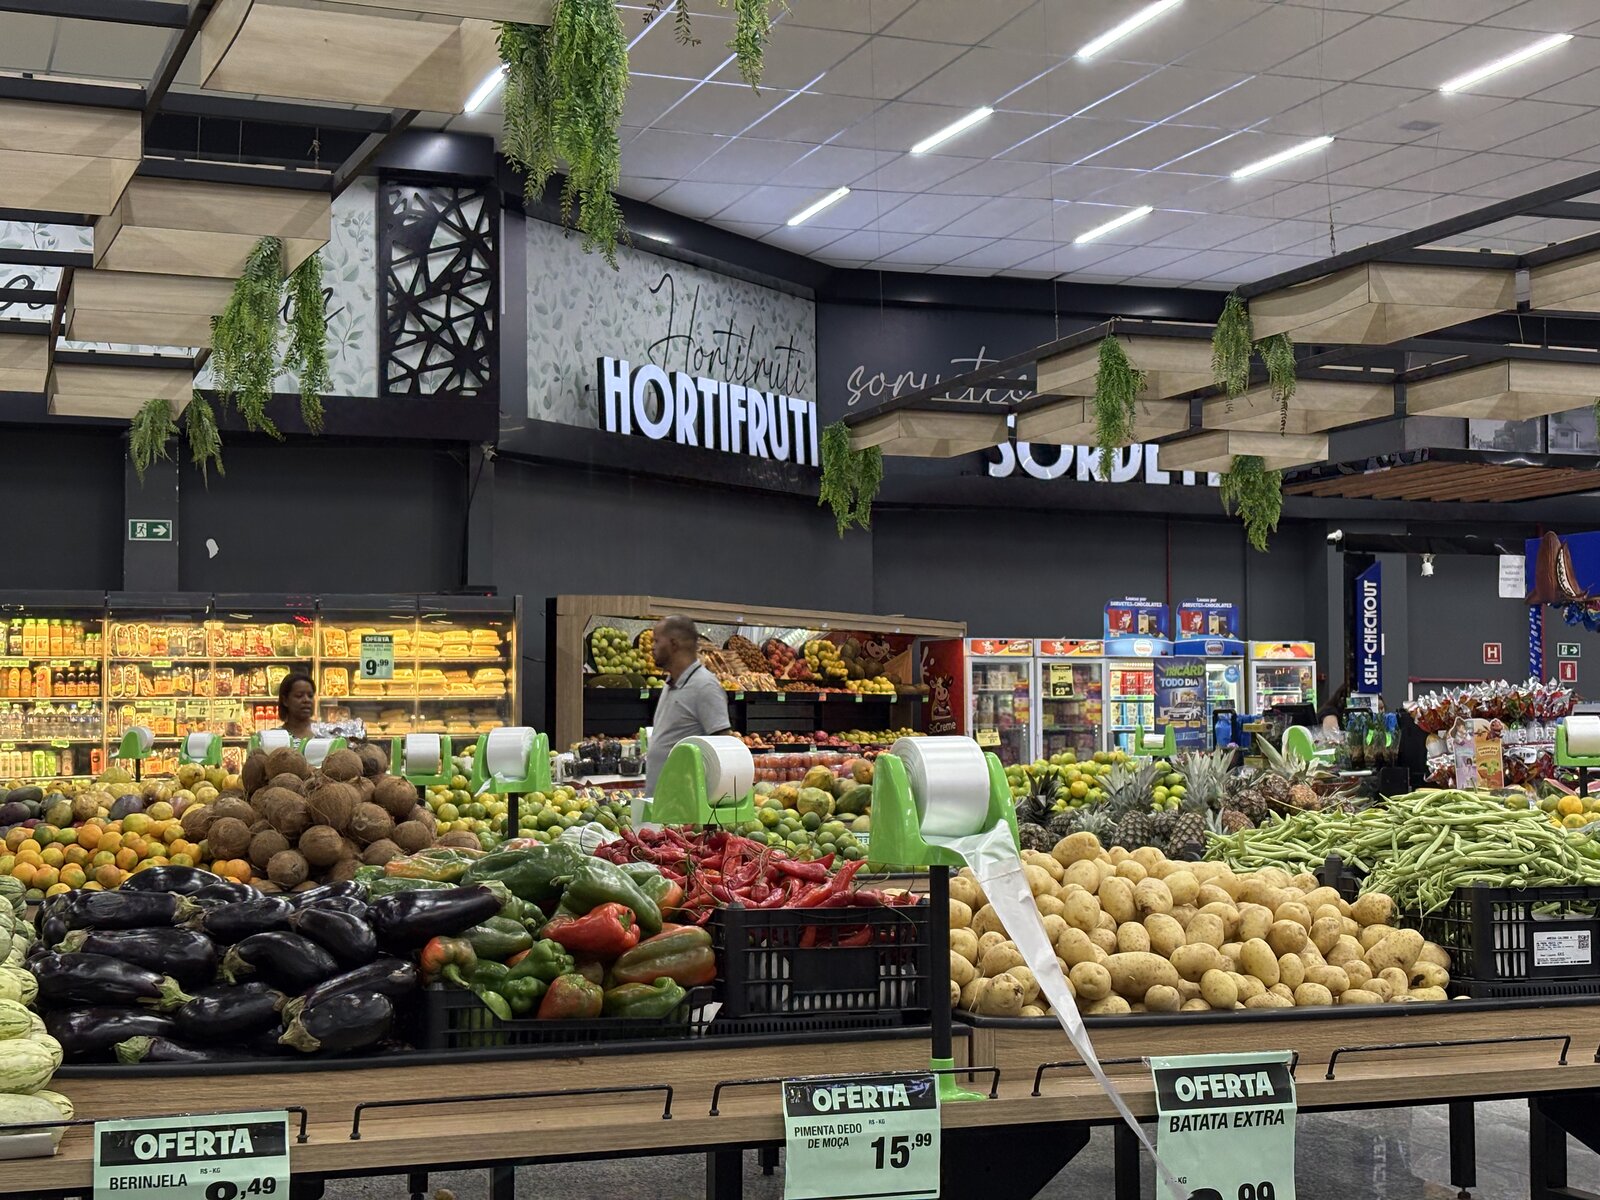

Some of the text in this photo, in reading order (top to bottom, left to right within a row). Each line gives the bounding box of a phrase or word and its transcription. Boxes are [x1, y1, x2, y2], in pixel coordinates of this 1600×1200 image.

[647, 272, 806, 396] Hortifruti
[598, 355, 819, 467] HORTIFRUTI
[1363, 579, 1378, 686] SELF-CHECKOUT
[1487, 646, 1498, 659] H
[1160, 678, 1199, 688] TODO DIA
[812, 1083, 910, 1112] OFERTA
[1174, 1071, 1275, 1102] OFERTA
[794, 1123, 862, 1137] PIMENTA DEDO
[1169, 1108, 1285, 1133] BATATA EXTRA
[133, 1127, 254, 1161] OFERTA
[807, 1137, 850, 1150] DE MOÇA
[870, 1132, 932, 1170] 15,99
[109, 1173, 188, 1191] BERINJELA
[1177, 1176, 1187, 1185] KG
